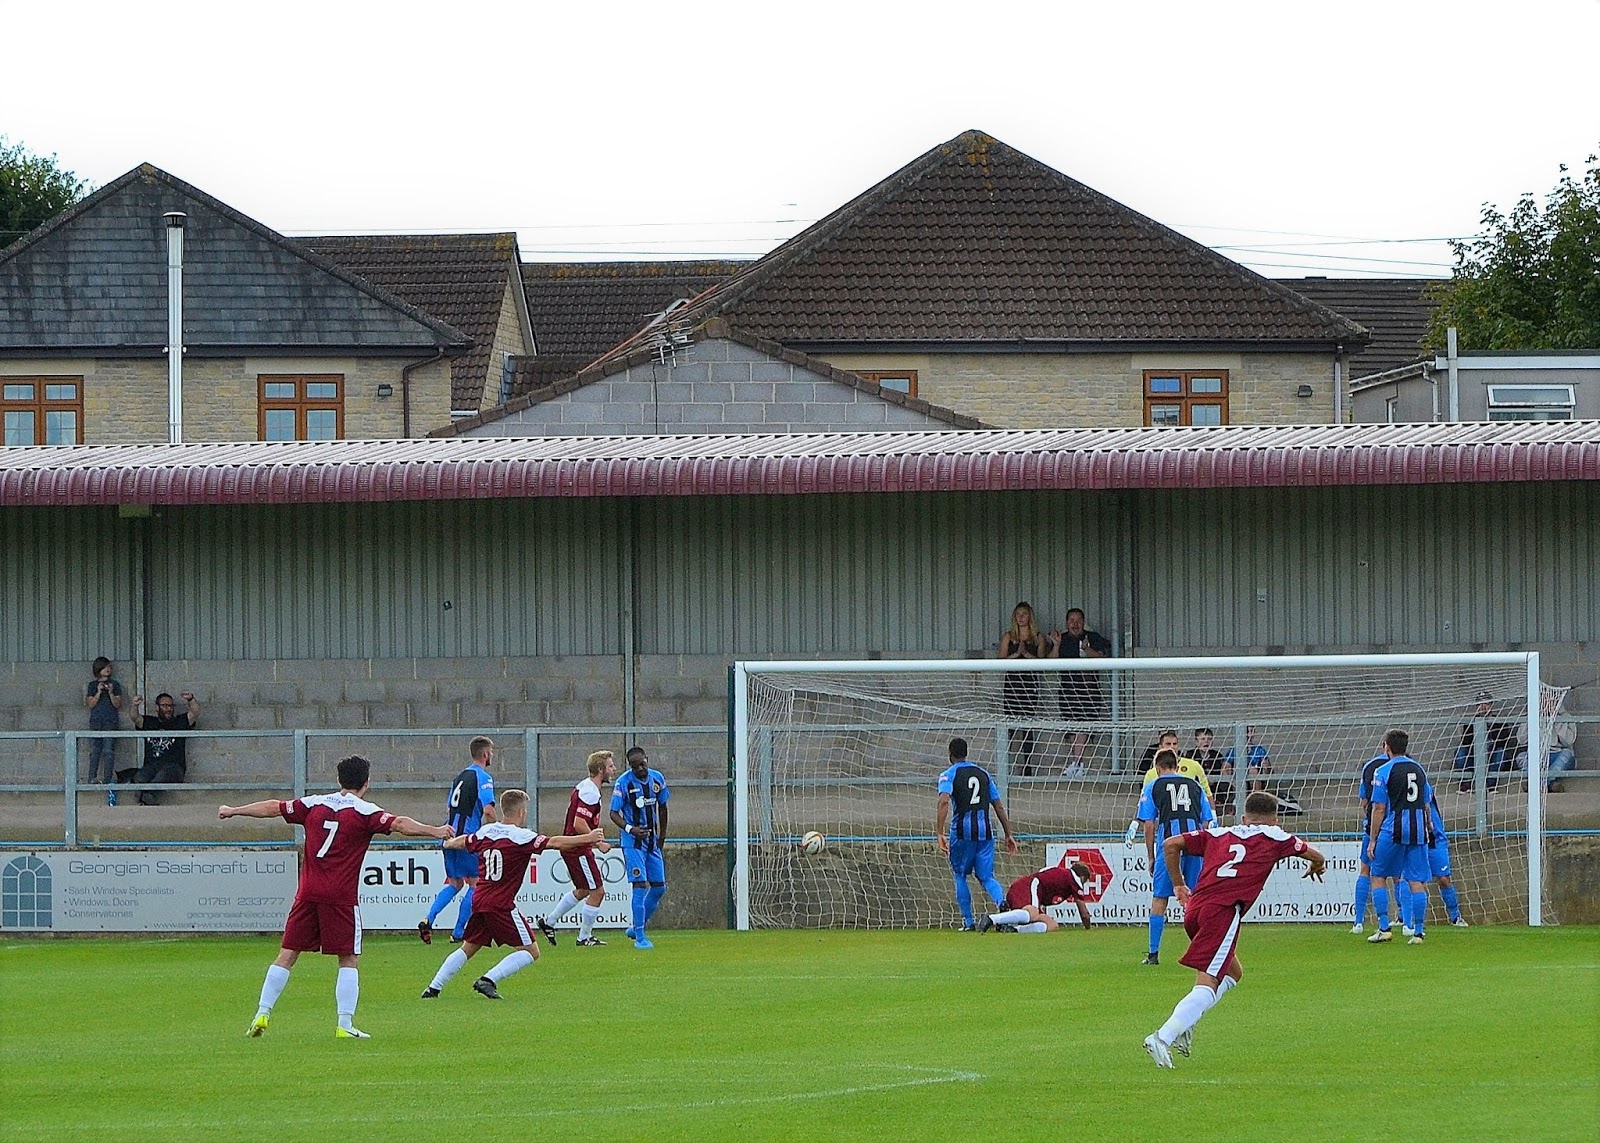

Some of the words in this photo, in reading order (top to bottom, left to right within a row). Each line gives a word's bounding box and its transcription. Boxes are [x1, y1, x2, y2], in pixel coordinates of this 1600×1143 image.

[451, 780, 464, 808] 6
[968, 776, 980, 805] 2
[1406, 773, 1419, 802] 5
[1166, 783, 1191, 812] 14
[316, 820, 339, 858] 7
[68, 860, 150, 876] Georgian
[156, 860, 248, 875] Sashcraft
[255, 860, 286, 874] Ltd
[482, 848, 503, 882] 10
[1123, 857, 1146, 871] E&
[1216, 844, 1247, 878] 2
[1276, 856, 1357, 873] Plasring
[363, 858, 430, 886] ath
[68, 886, 90, 895] Sash
[92, 886, 127, 895] Window
[129, 886, 175, 897] Specialists
[359, 893, 380, 904] first
[382, 893, 414, 904] choice
[417, 893, 432, 904] for
[531, 892, 556, 903] Used
[604, 892, 628, 902] Bath
[68, 898, 111, 907] Windows,
[112, 897, 139, 907] Doors
[237, 897, 285, 906] 233777
[1258, 902, 1299, 917] 01278
[1306, 902, 1357, 917] 420976
[68, 909, 134, 918] Conservatories
